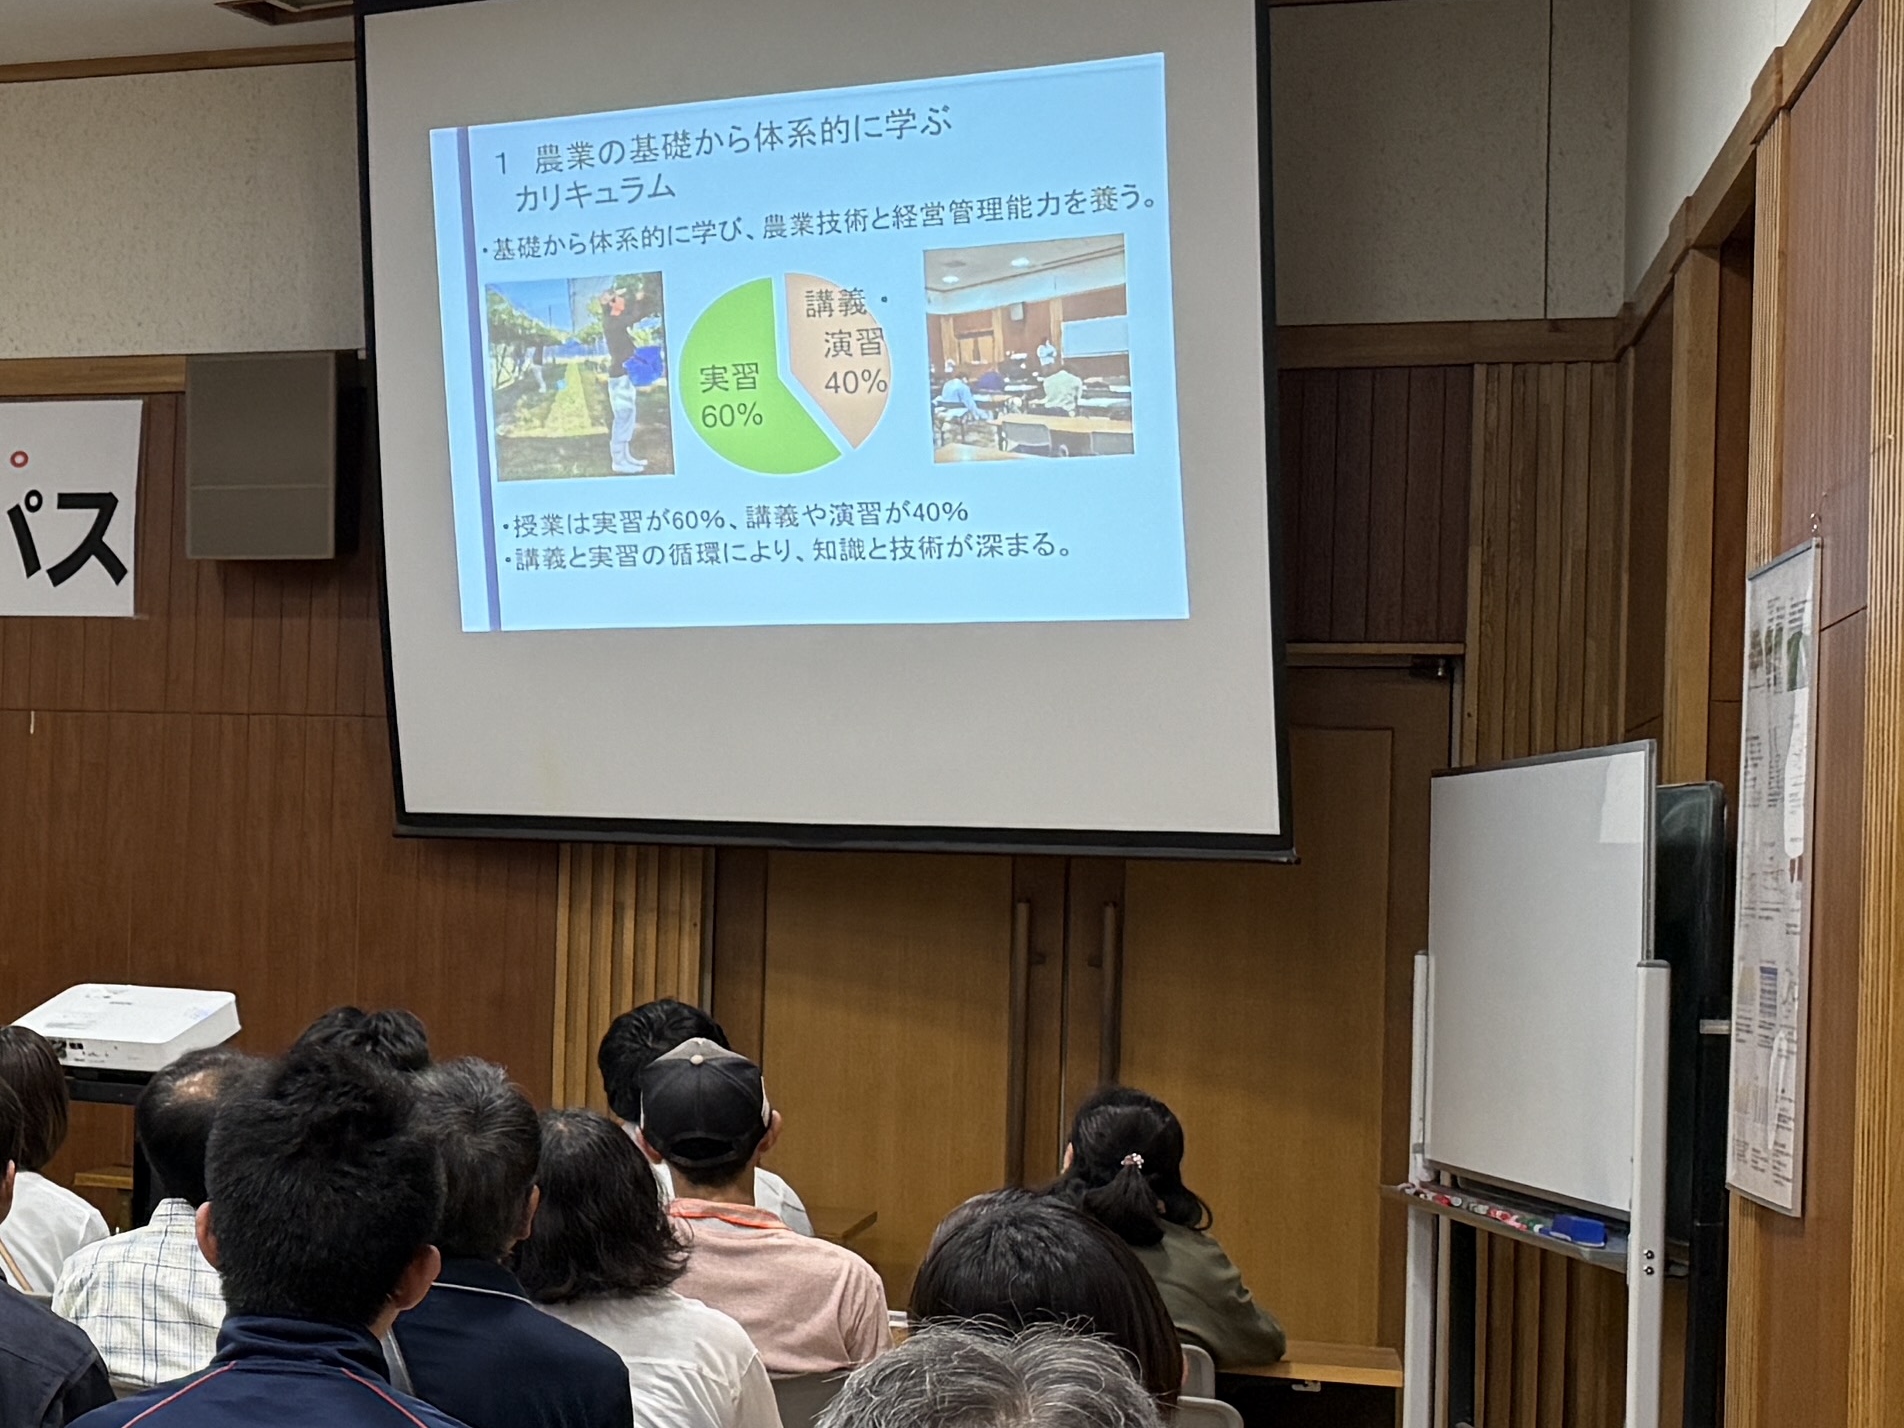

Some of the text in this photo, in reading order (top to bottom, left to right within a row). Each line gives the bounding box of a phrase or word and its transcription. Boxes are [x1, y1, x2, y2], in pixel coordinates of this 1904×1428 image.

[495, 105, 952, 176] 1 農業の基礎から体系的に学ぶ
[515, 173, 677, 214] カリキュラム
[824, 326, 885, 359] 演習
[699, 361, 760, 394] 実習
[824, 368, 889, 395] 40%
[701, 401, 764, 429] 60%
